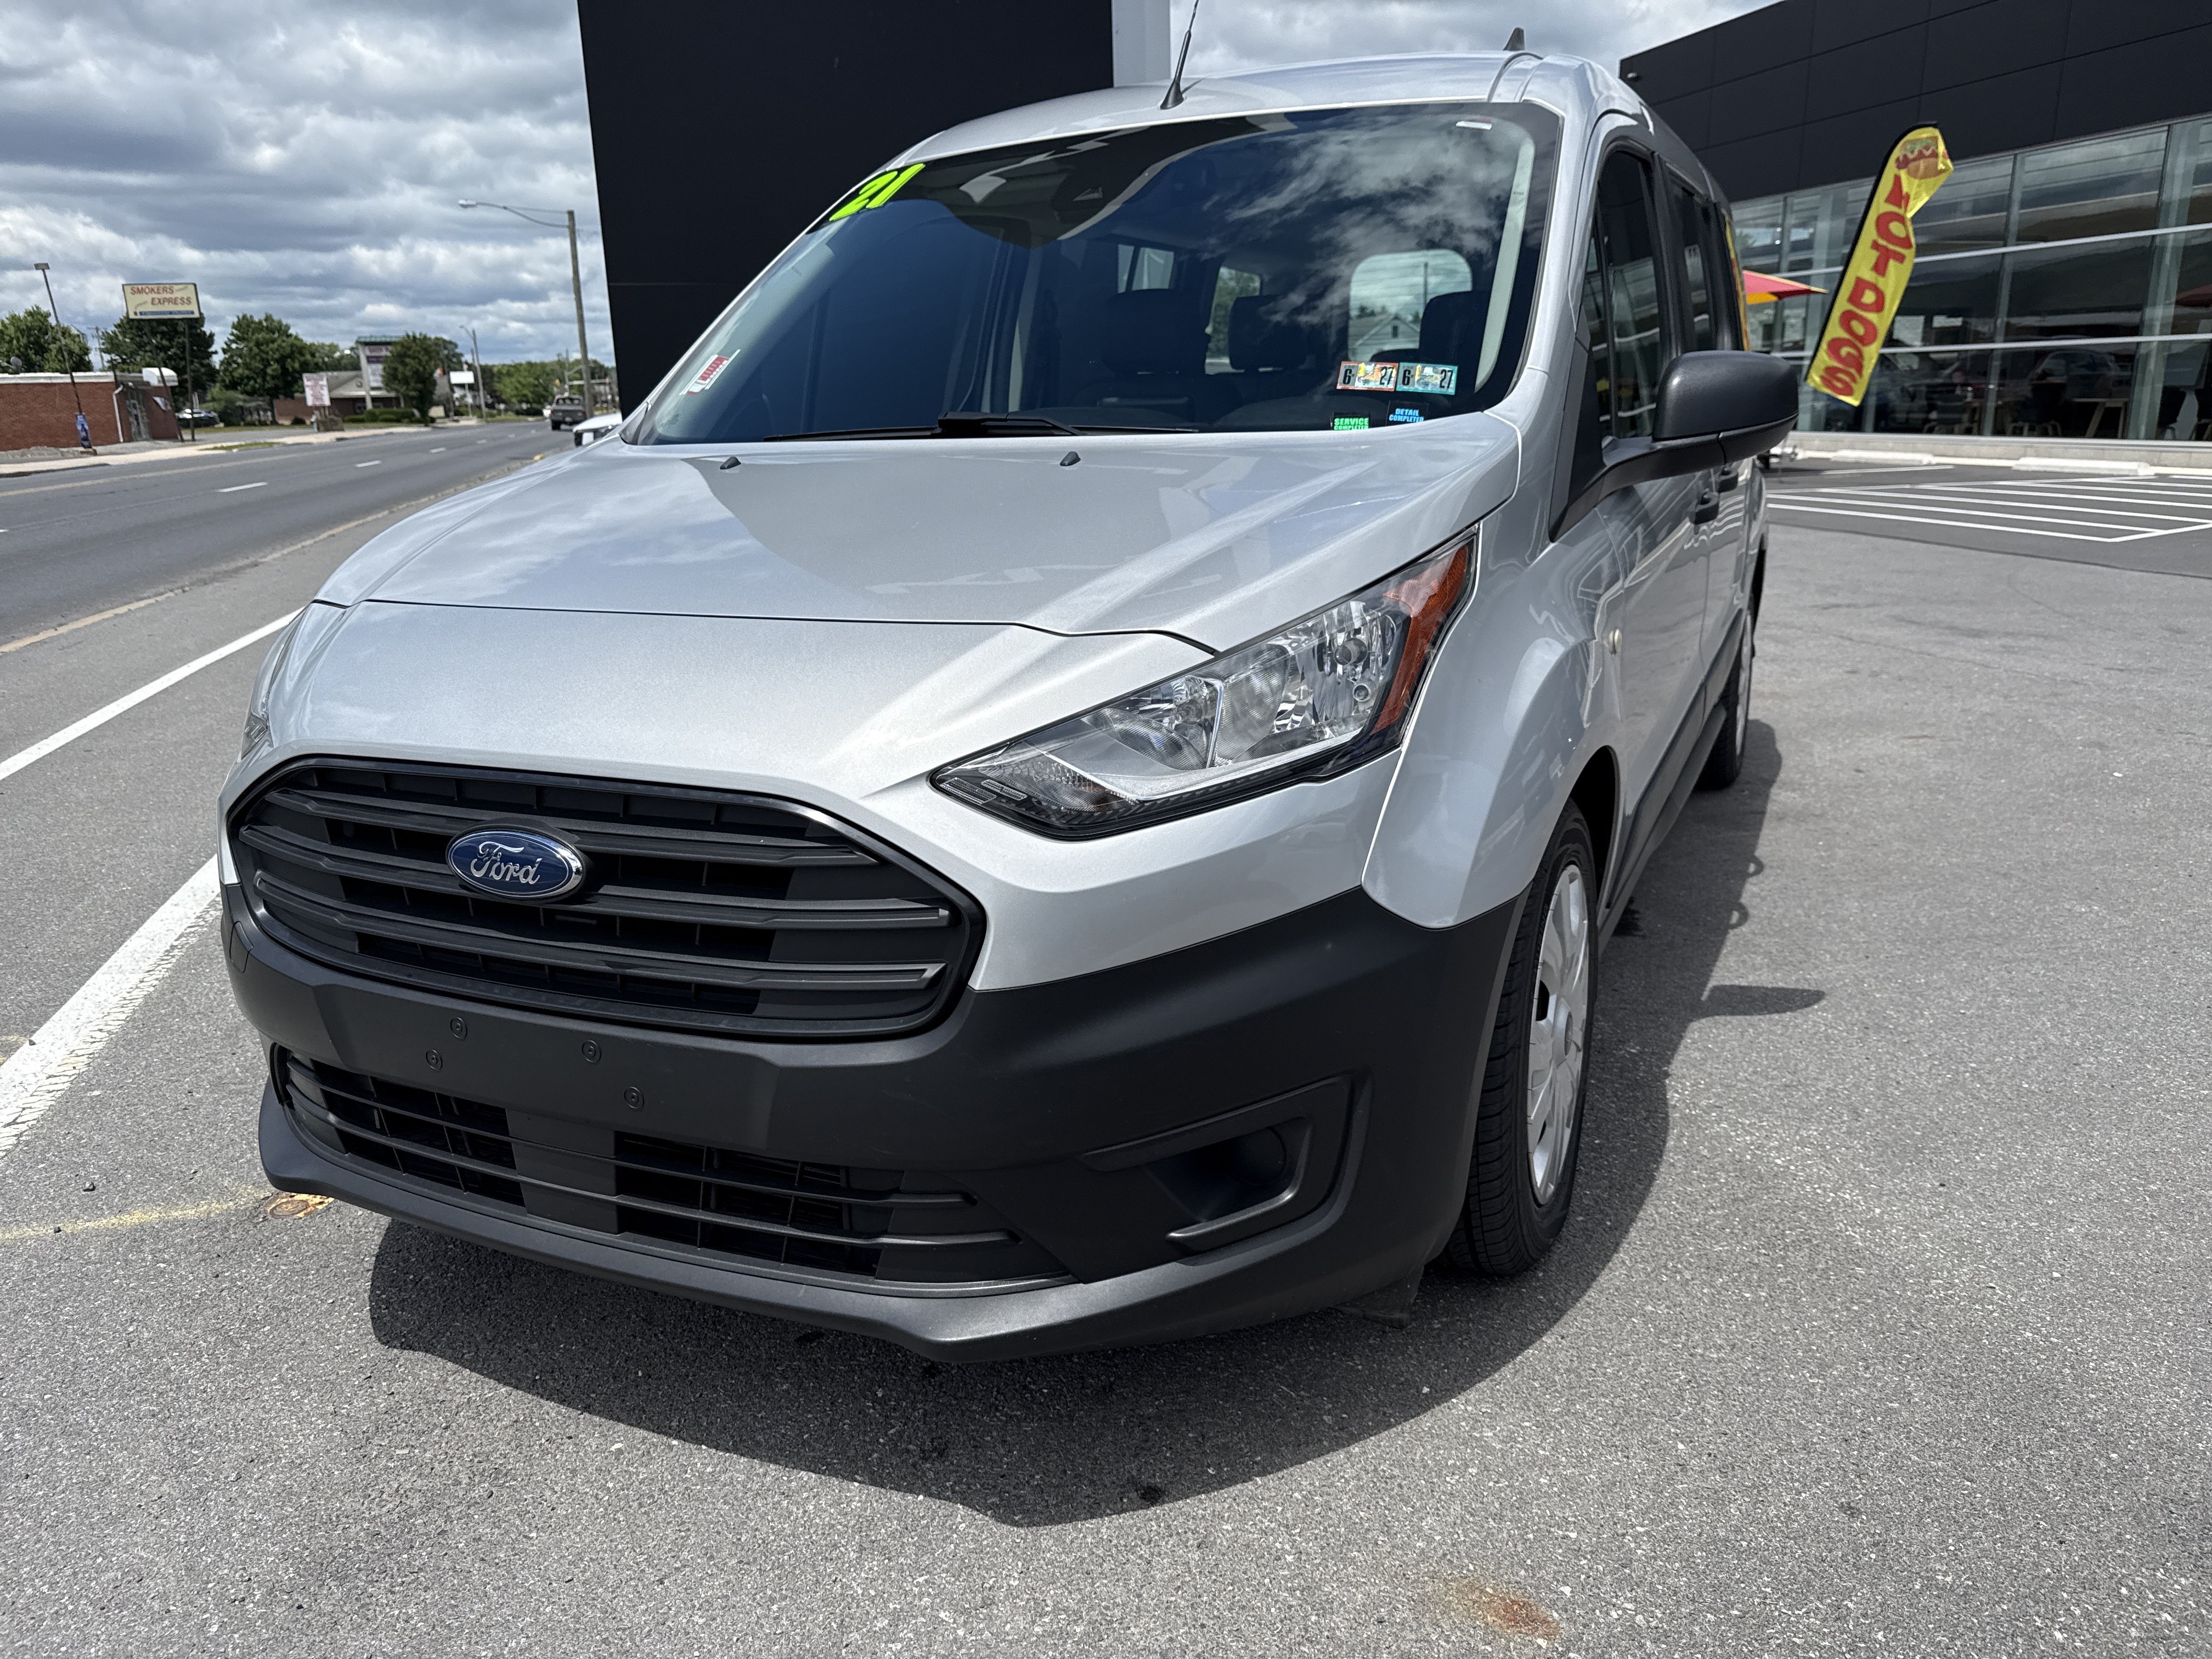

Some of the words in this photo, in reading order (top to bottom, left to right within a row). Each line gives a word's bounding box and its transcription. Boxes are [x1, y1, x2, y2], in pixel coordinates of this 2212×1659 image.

[829, 163, 926, 222] 21
[130, 286, 174, 295] SMOKERS
[151, 296, 192, 306] EXPRESS
[1820, 276, 1885, 397] DOGS
[1342, 368, 1353, 385] 6
[1379, 366, 1395, 388] 27
[1402, 369, 1412, 386] 6
[1439, 369, 1454, 391] 27
[1389, 414, 1425, 422] COMPLETED
[1395, 408, 1420, 416] DETAIL
[1334, 417, 1369, 426] SERVICE
[470, 841, 543, 885] Ford
